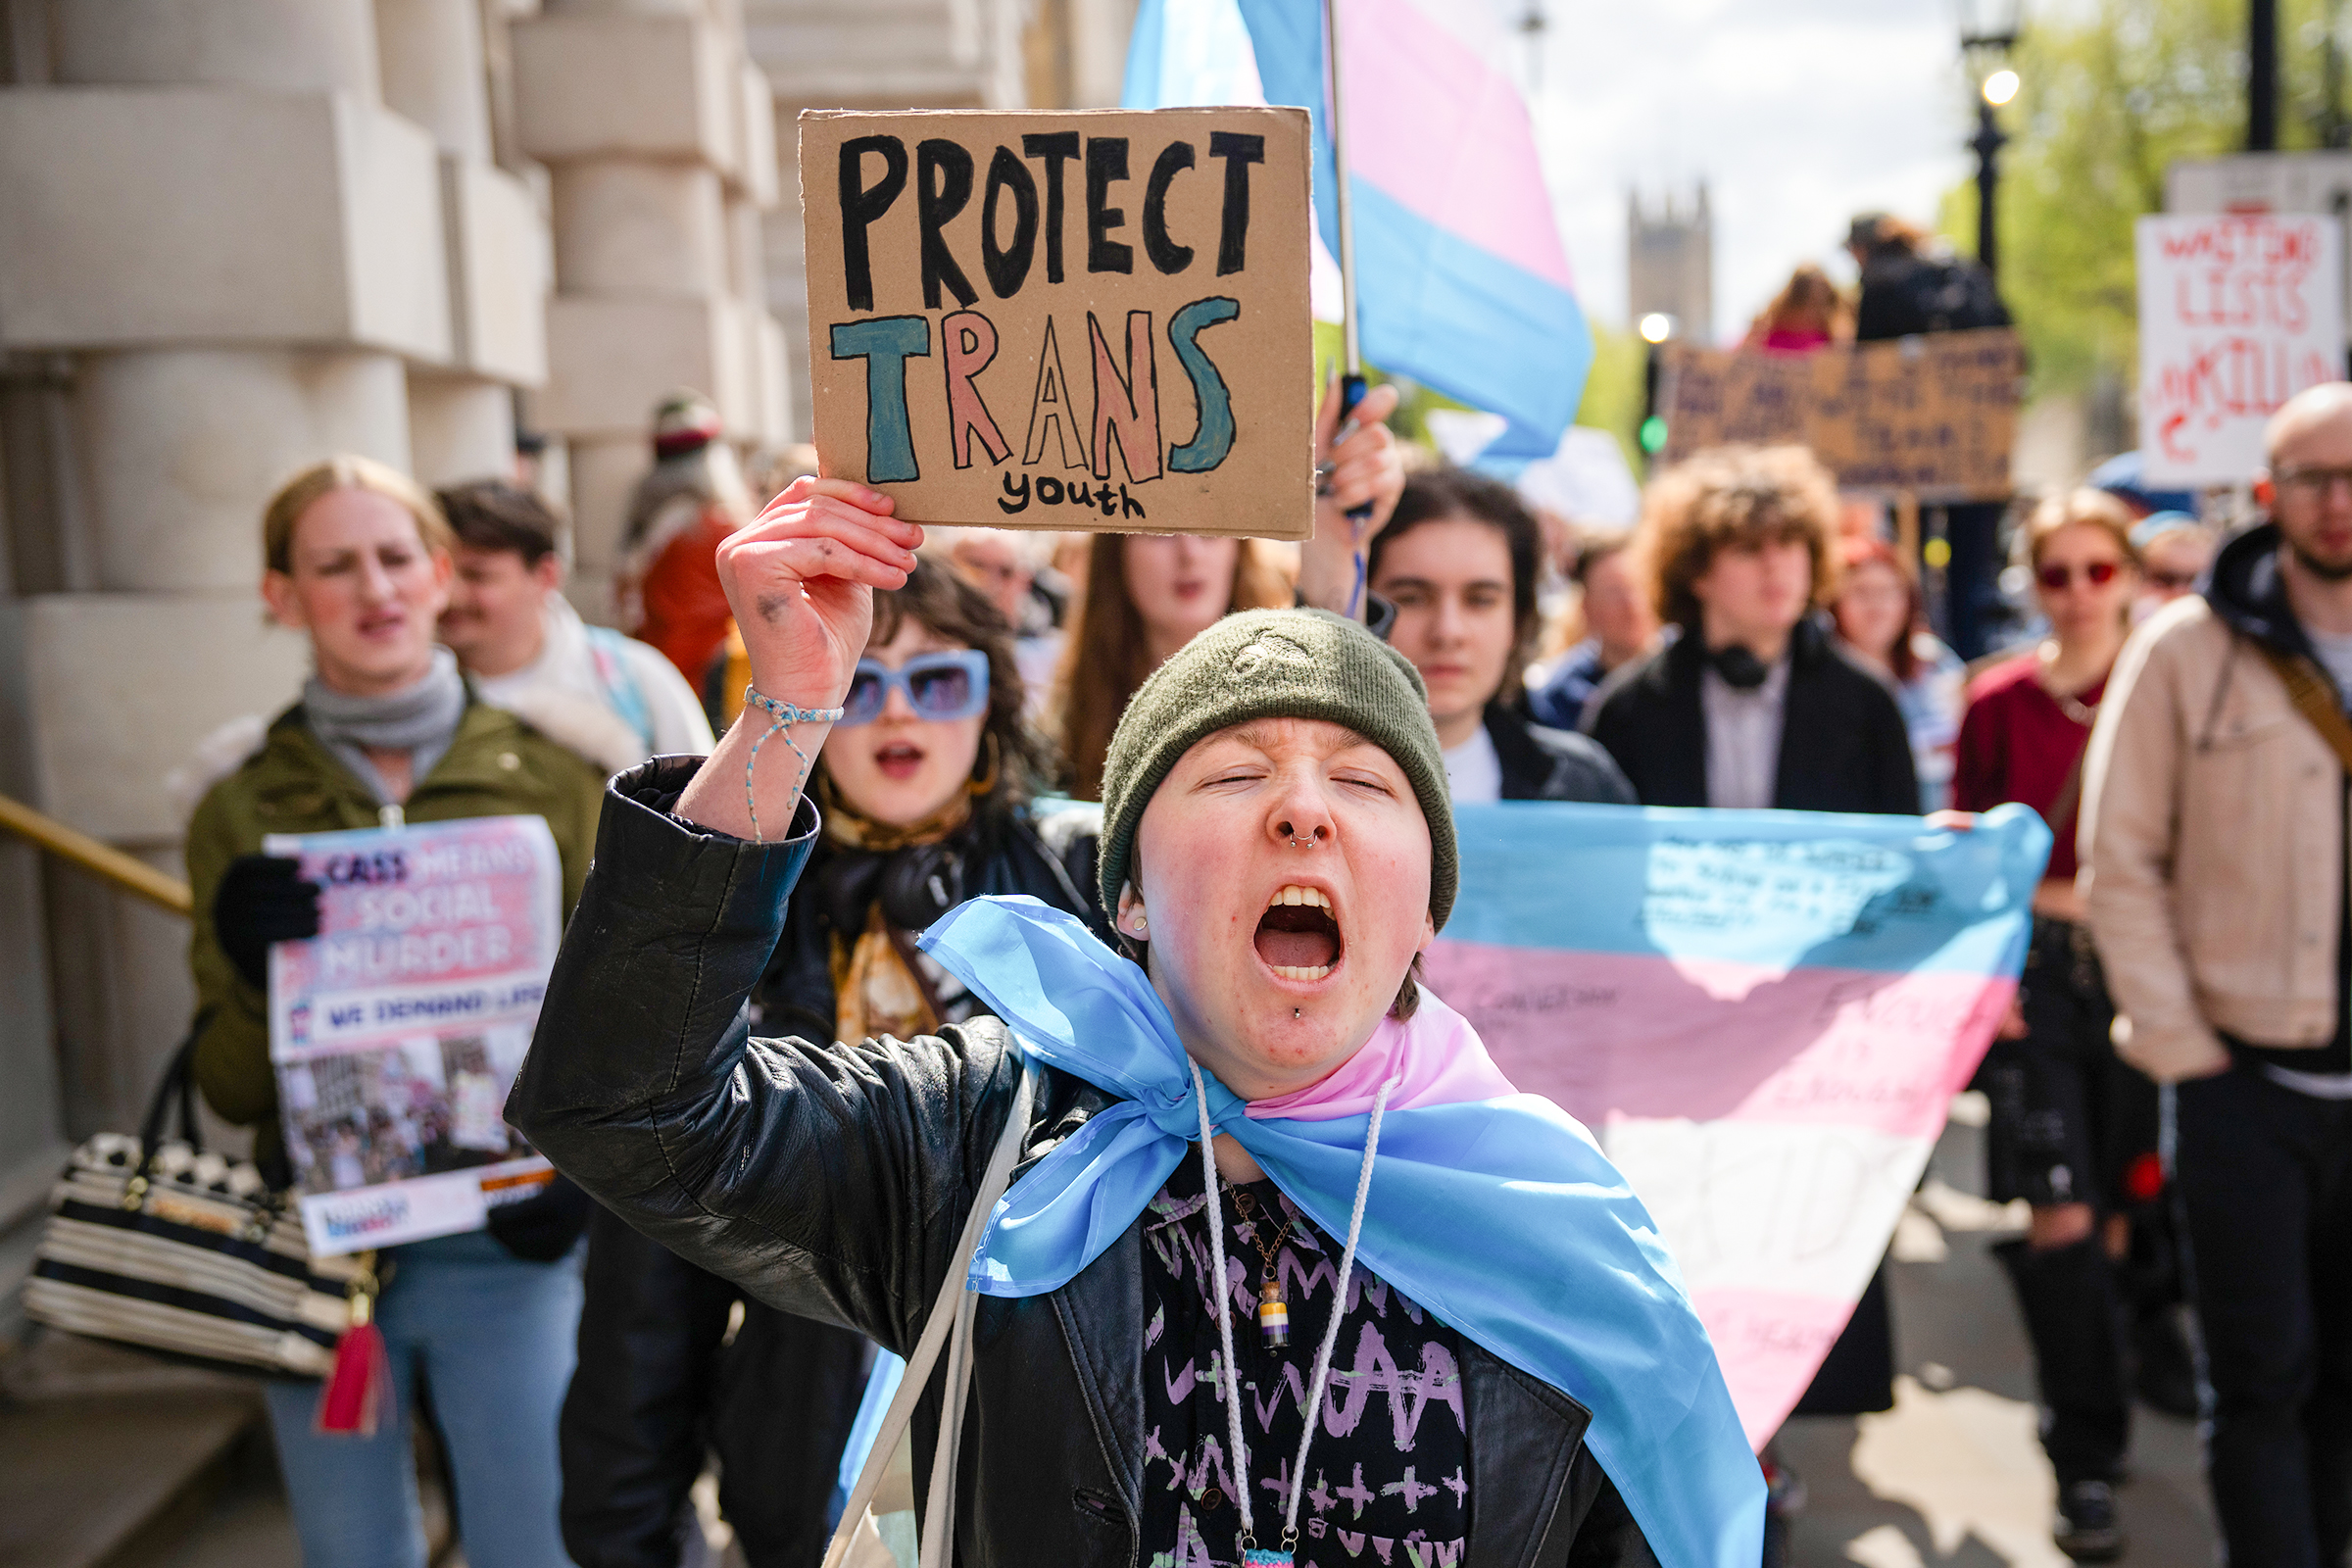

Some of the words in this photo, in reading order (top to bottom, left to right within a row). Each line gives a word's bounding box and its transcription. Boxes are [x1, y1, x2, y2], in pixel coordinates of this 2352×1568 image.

[838, 130, 1266, 312] PROTECT
[2175, 269, 2311, 335] LISTS
[828, 296, 1241, 484] TRANS
[998, 471, 1147, 519] youth
[325, 849, 408, 884] CASS
[359, 886, 501, 930] SOCIAL
[322, 926, 512, 977] MURDER
[328, 1004, 363, 1027] WE
[376, 991, 483, 1019] DEMAND
